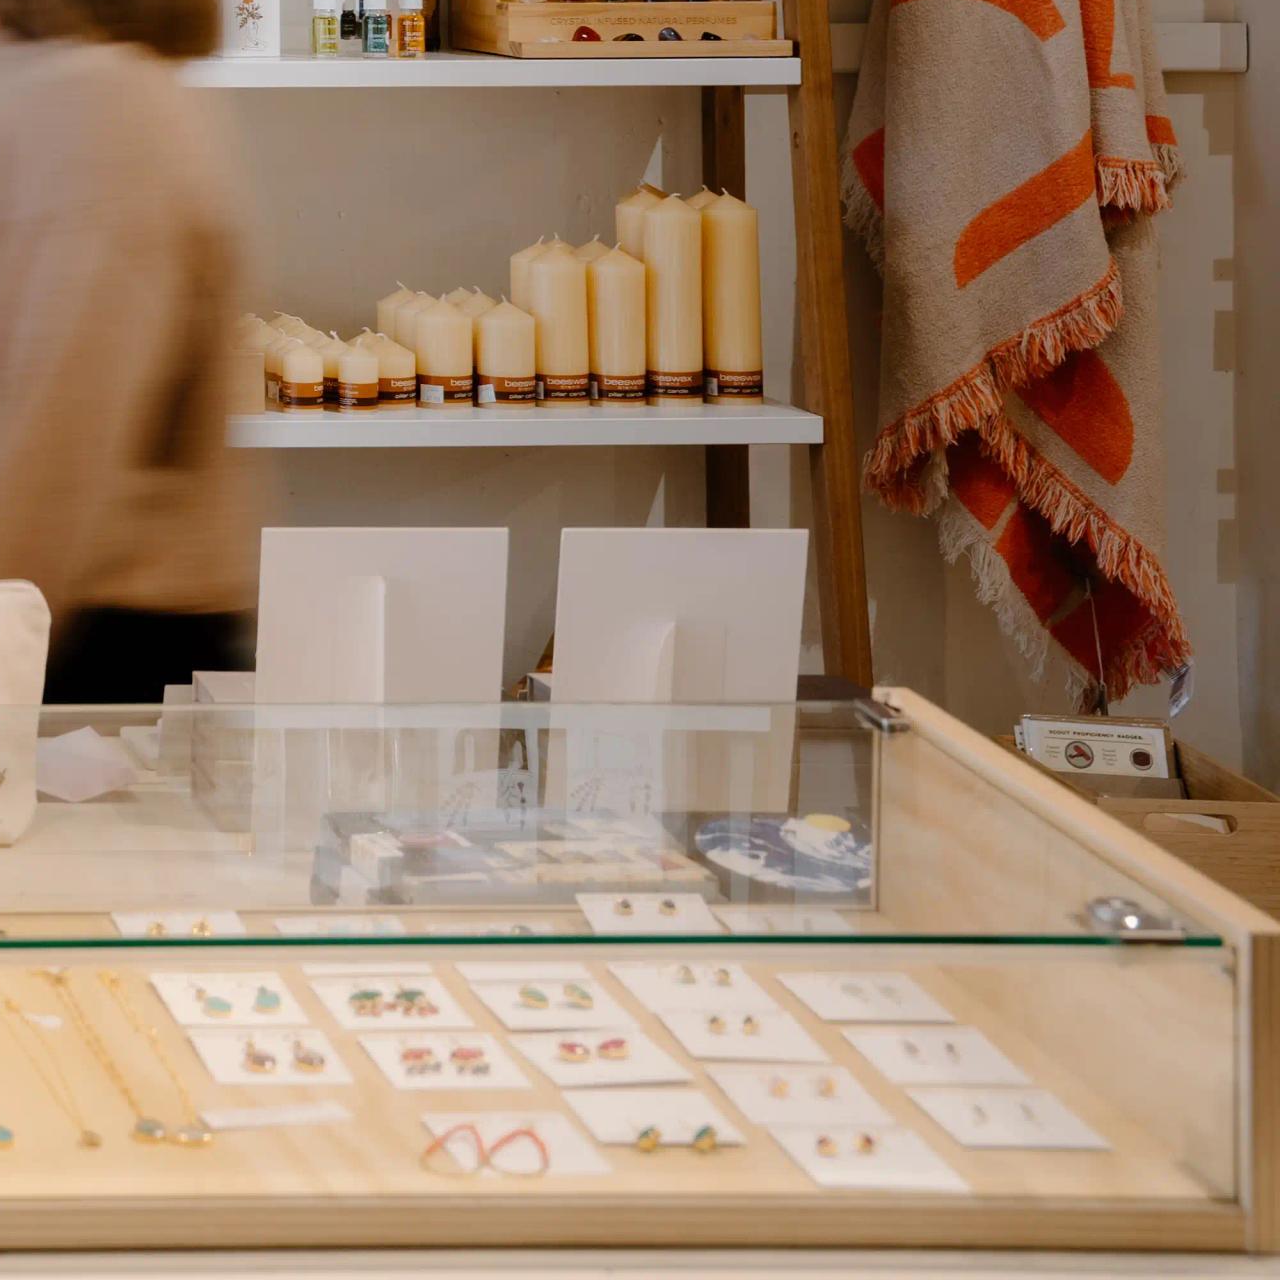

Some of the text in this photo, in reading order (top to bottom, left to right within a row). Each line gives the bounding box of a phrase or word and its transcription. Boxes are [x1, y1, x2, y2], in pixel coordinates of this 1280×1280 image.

[550, 17, 737, 26] CRYSTAL INFUSED NATURAL PERFUMES
[1048, 729, 1070, 737] SCOUT
